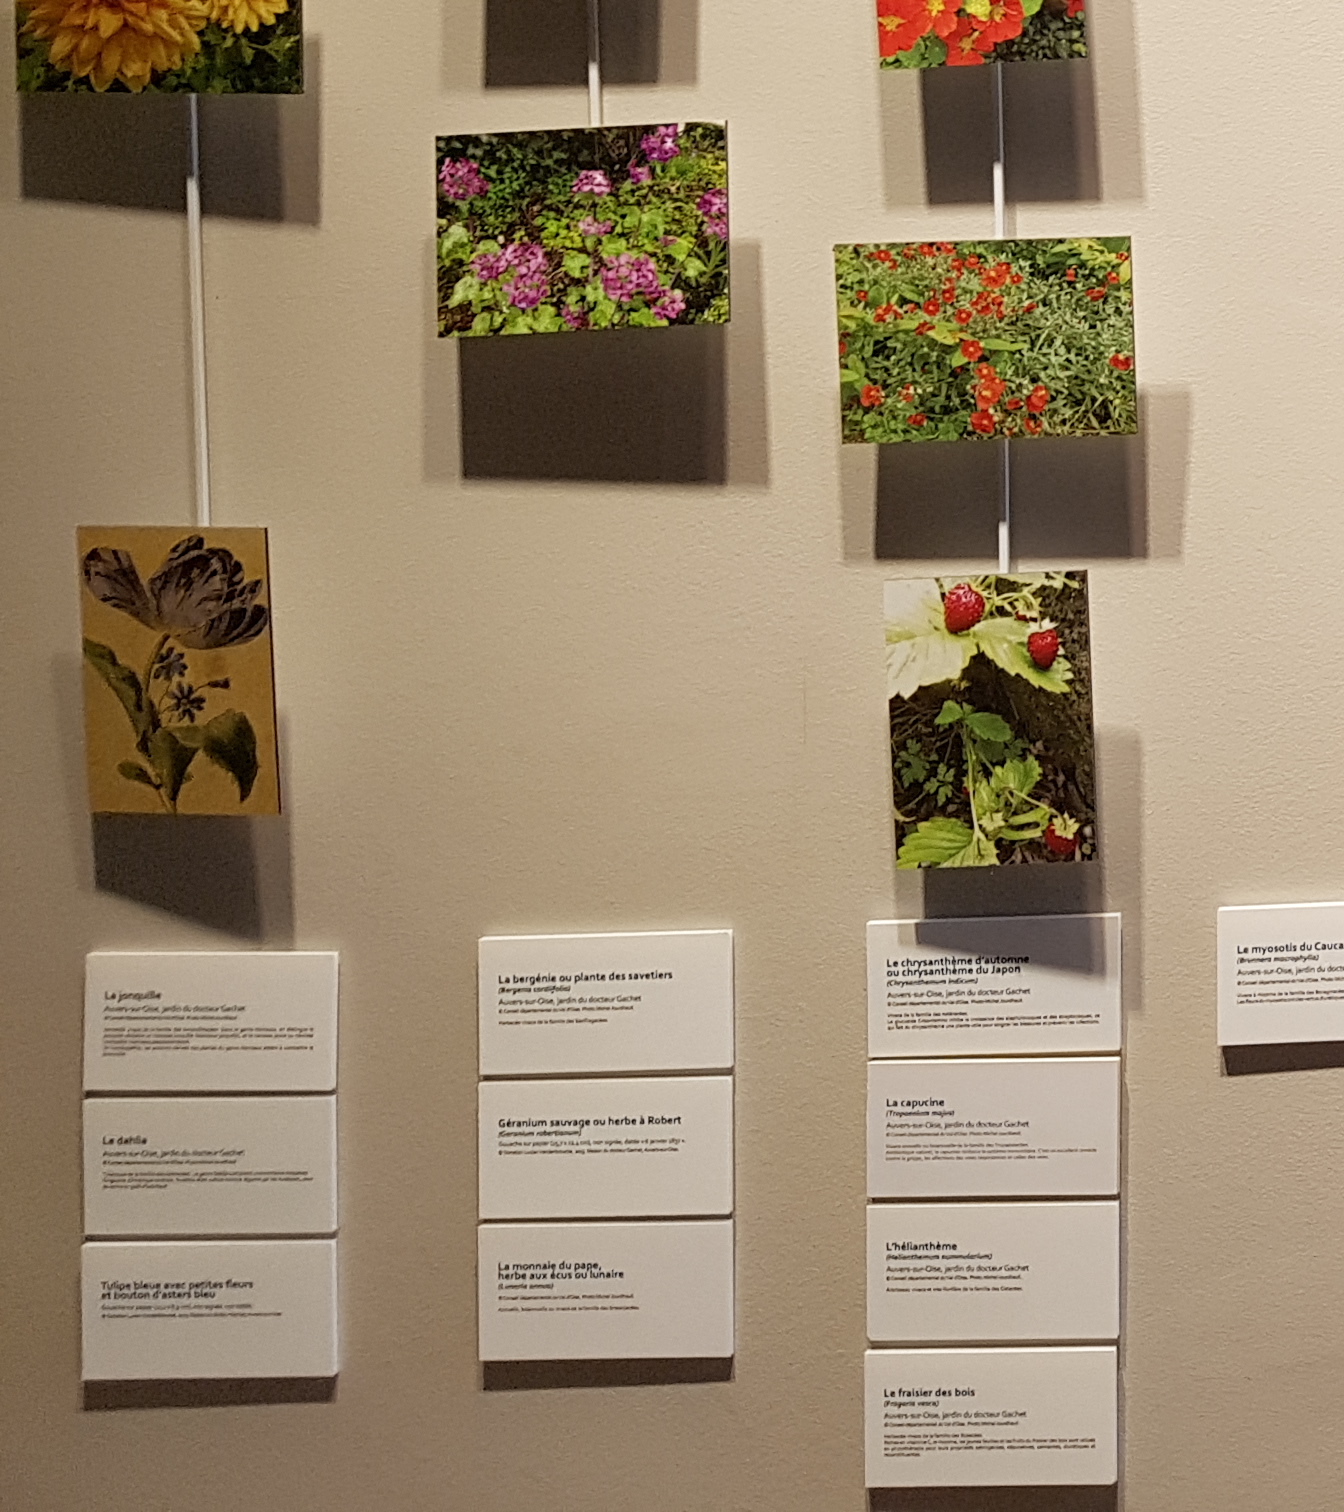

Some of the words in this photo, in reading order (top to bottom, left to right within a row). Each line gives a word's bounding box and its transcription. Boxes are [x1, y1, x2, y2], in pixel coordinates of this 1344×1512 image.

[1237, 945, 1249, 954] Le
[1251, 943, 1297, 956] myosotis
[1299, 942, 1312, 952] du
[886, 959, 898, 968] Le
[900, 956, 973, 969] chrysanthème
[498, 974, 510, 984] La
[512, 973, 556, 985] bergénie
[574, 972, 605, 984] plante
[608, 972, 625, 981] des
[628, 970, 672, 980] savetiers
[886, 969, 899, 977] ou
[901, 966, 973, 978] chrysanthème
[975, 966, 988, 975] du
[990, 965, 1021, 976] Japon
[886, 1098, 898, 1107] La
[900, 1098, 944, 1109] capucine
[498, 1117, 547, 1127] Géranium
[549, 1119, 590, 1129] sauvage
[608, 1117, 636, 1126] herbe
[639, 1116, 645, 1125] à
[647, 1116, 681, 1125] Robert
[497, 1262, 509, 1271] La
[512, 1261, 556, 1271] monnaie
[558, 1261, 571, 1270] du
[573, 1263, 601, 1272] pape,
[497, 1271, 526, 1280] herbe
[529, 1272, 547, 1280] aux
[549, 1270, 572, 1279] écus
[589, 1270, 624, 1279] lunaire
[883, 1389, 895, 1398] Le
[898, 1388, 932, 1397] fraisier
[934, 1388, 952, 1397] des
[954, 1388, 975, 1397] bois
